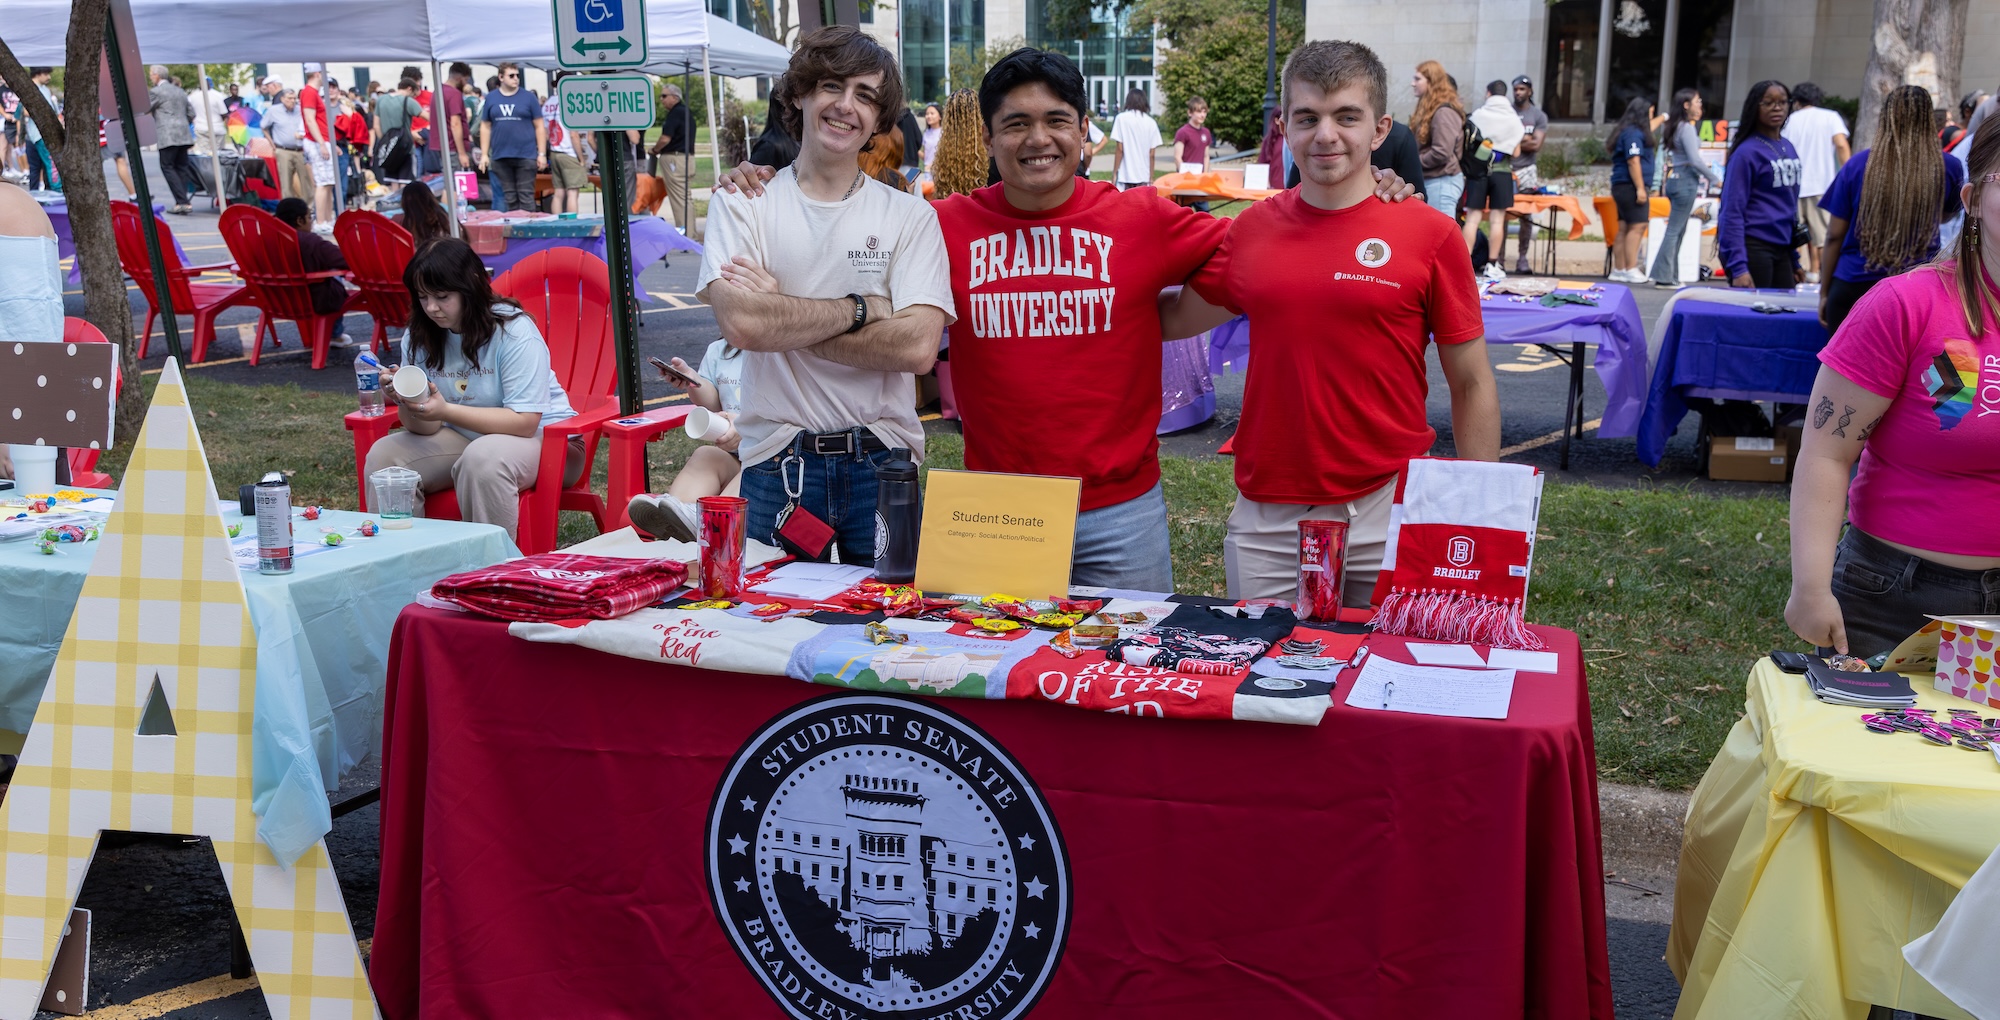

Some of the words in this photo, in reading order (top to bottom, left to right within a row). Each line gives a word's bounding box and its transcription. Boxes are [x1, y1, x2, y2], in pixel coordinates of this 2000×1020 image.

[499, 103, 515, 117] W
[566, 91, 603, 116] $350
[607, 91, 646, 113] FINE
[847, 250, 893, 260] BRADLEY
[852, 259, 888, 269] University
[969, 226, 1114, 290] BRADLEY
[1341, 272, 1376, 283] BRADLEY
[1375, 277, 1402, 290] University
[969, 286, 1116, 339] UNIVERSITY
[1977, 354, 2000, 418] YOUR
[952, 510, 999, 525] Student
[1001, 513, 1044, 528] Senate
[947, 529, 977, 539] Category:
[978, 532, 998, 540] Social
[998, 533, 1046, 543] Action/Political
[1452, 541, 1469, 562] B
[1433, 567, 1482, 581] BRADLEY
[659, 636, 702, 666] Red
[1038, 671, 1099, 705] OF
[1108, 676, 1203, 700] THE
[761, 714, 895, 778] STUDENT
[903, 720, 1019, 811] SENATE
[744, 915, 858, 1020] BRADLEY
